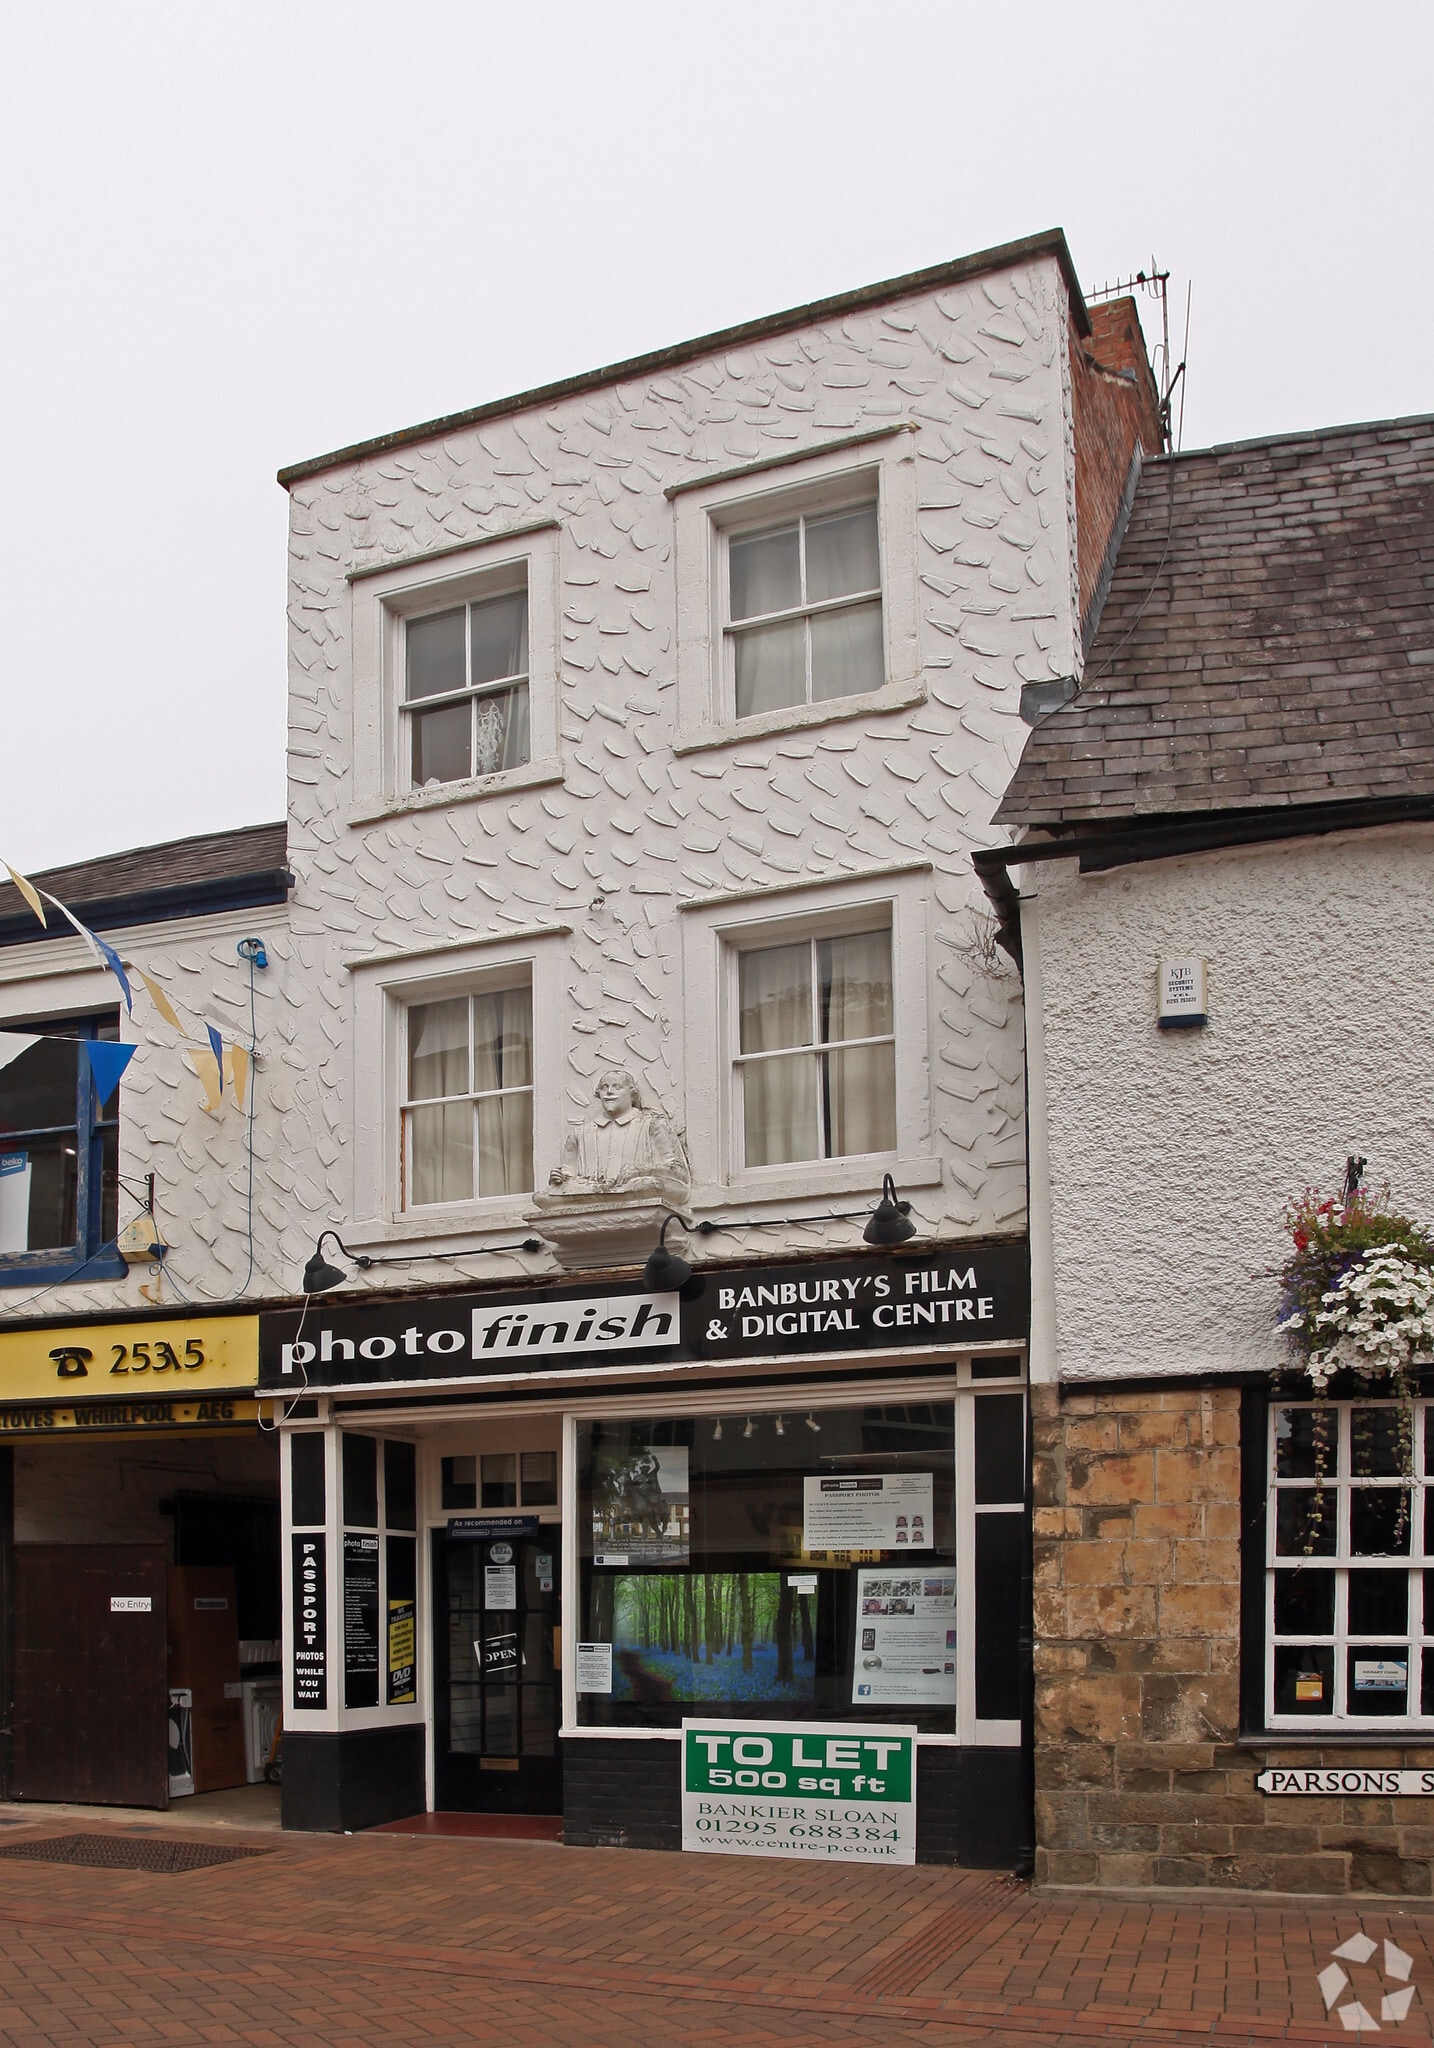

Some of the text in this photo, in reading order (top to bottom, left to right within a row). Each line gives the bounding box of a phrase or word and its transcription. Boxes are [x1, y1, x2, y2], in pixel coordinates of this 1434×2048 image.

[1171, 968, 1192, 979] KJB
[1, 1157, 23, 1166] beko
[718, 1267, 977, 1310] BANBURY'S FILM
[705, 1297, 994, 1341] & DIGITAL CENTRE
[281, 1304, 673, 1374] photo finish
[0, 1402, 235, 1428] TOVES WHIRLPOOL AEG
[464, 1518, 512, 1527] recommended
[344, 1539, 360, 1548] photo
[303, 1544, 317, 1644] PASSPORT
[113, 1600, 149, 1610] No Entry
[391, 1611, 413, 1623] TRANSFER
[296, 1651, 324, 1661] PHOTOS
[485, 1648, 517, 1662] OPEN
[296, 1668, 324, 1676] WHILE
[393, 1666, 411, 1682] DVD
[300, 1679, 319, 1687] YOU
[695, 1735, 901, 1771] TO LET
[708, 1769, 886, 1796] 500 sq ft
[1271, 1772, 1400, 1792] PARSONS
[698, 1803, 898, 1825] BANKIER SLOAN
[695, 1818, 901, 1842] 01295 688384
[699, 1836, 897, 1855] www.centre-p.co.uk
